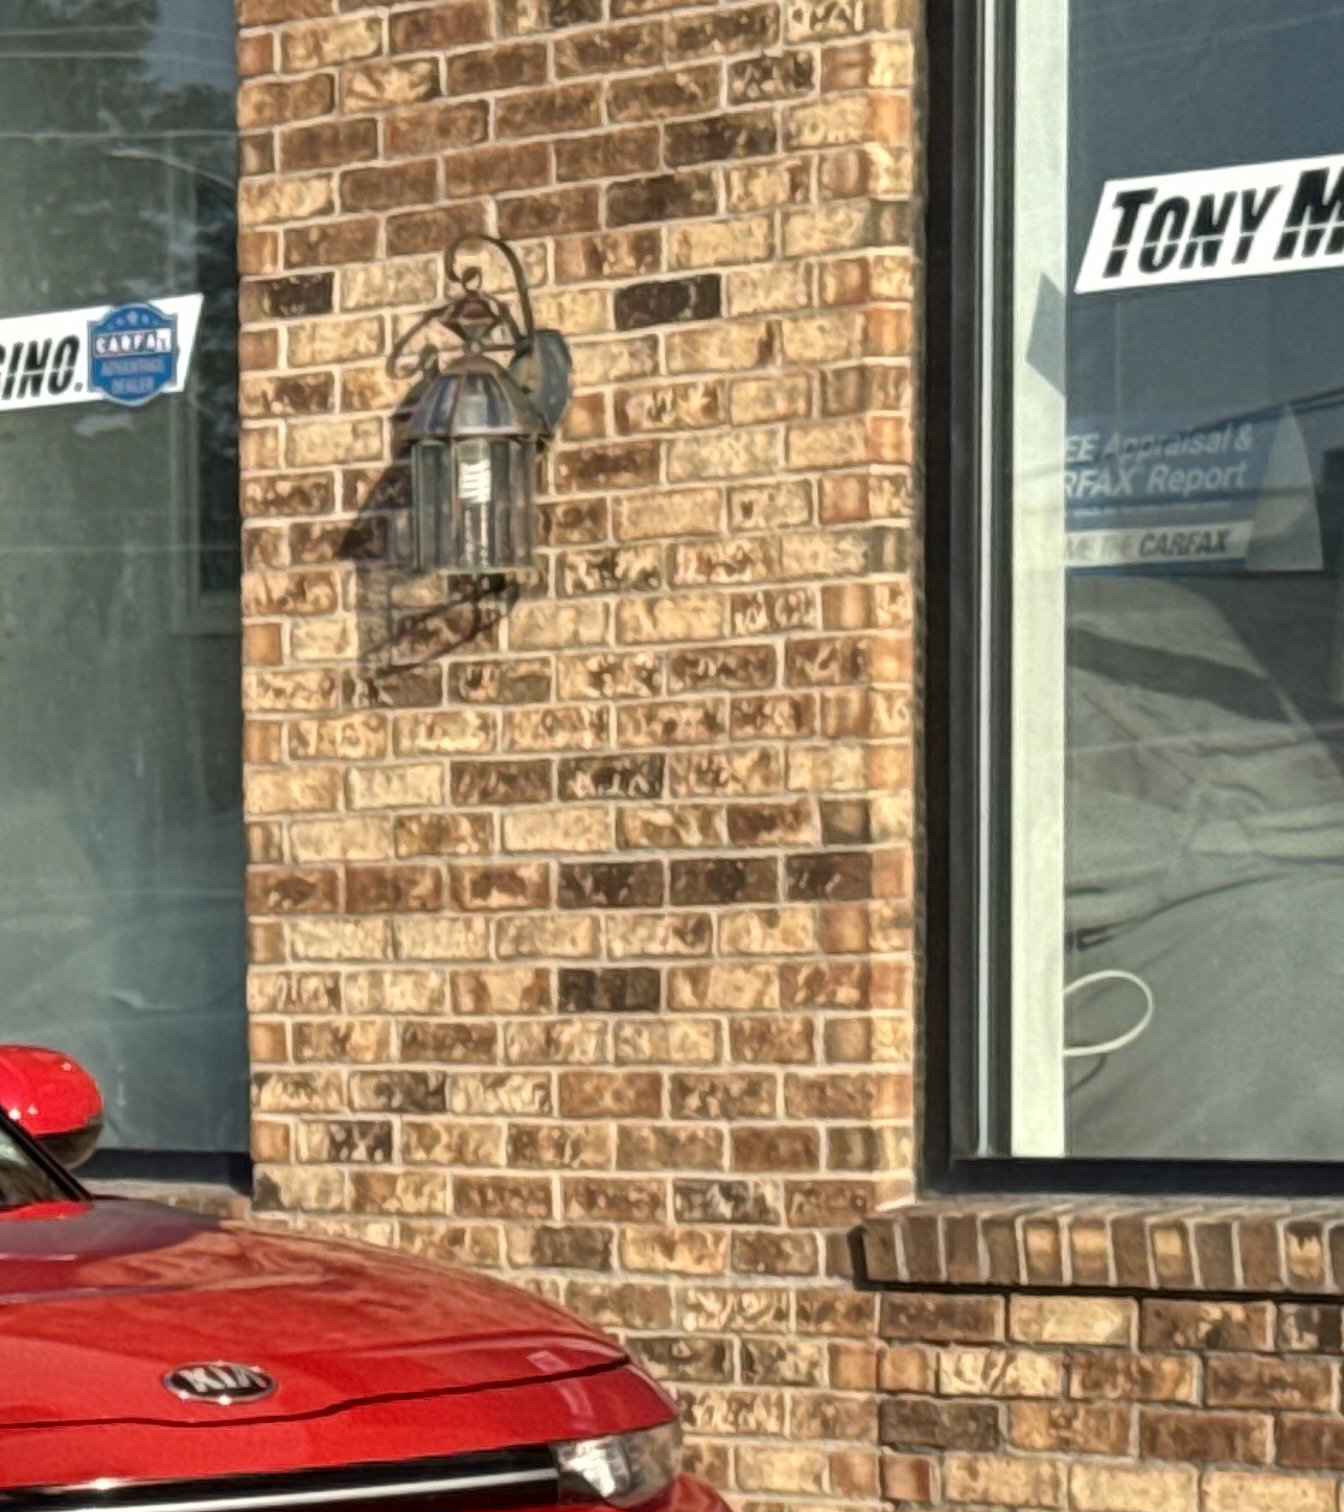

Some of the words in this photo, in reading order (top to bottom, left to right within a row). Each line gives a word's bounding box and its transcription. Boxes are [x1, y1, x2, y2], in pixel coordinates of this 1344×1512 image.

[1102, 184, 1284, 279] TONY
[1103, 423, 1233, 464] Appraisal
[1234, 422, 1254, 453] &
[1146, 461, 1249, 498] Report
[1139, 528, 1231, 557] CARFAX
[178, 1364, 268, 1393] KIA
